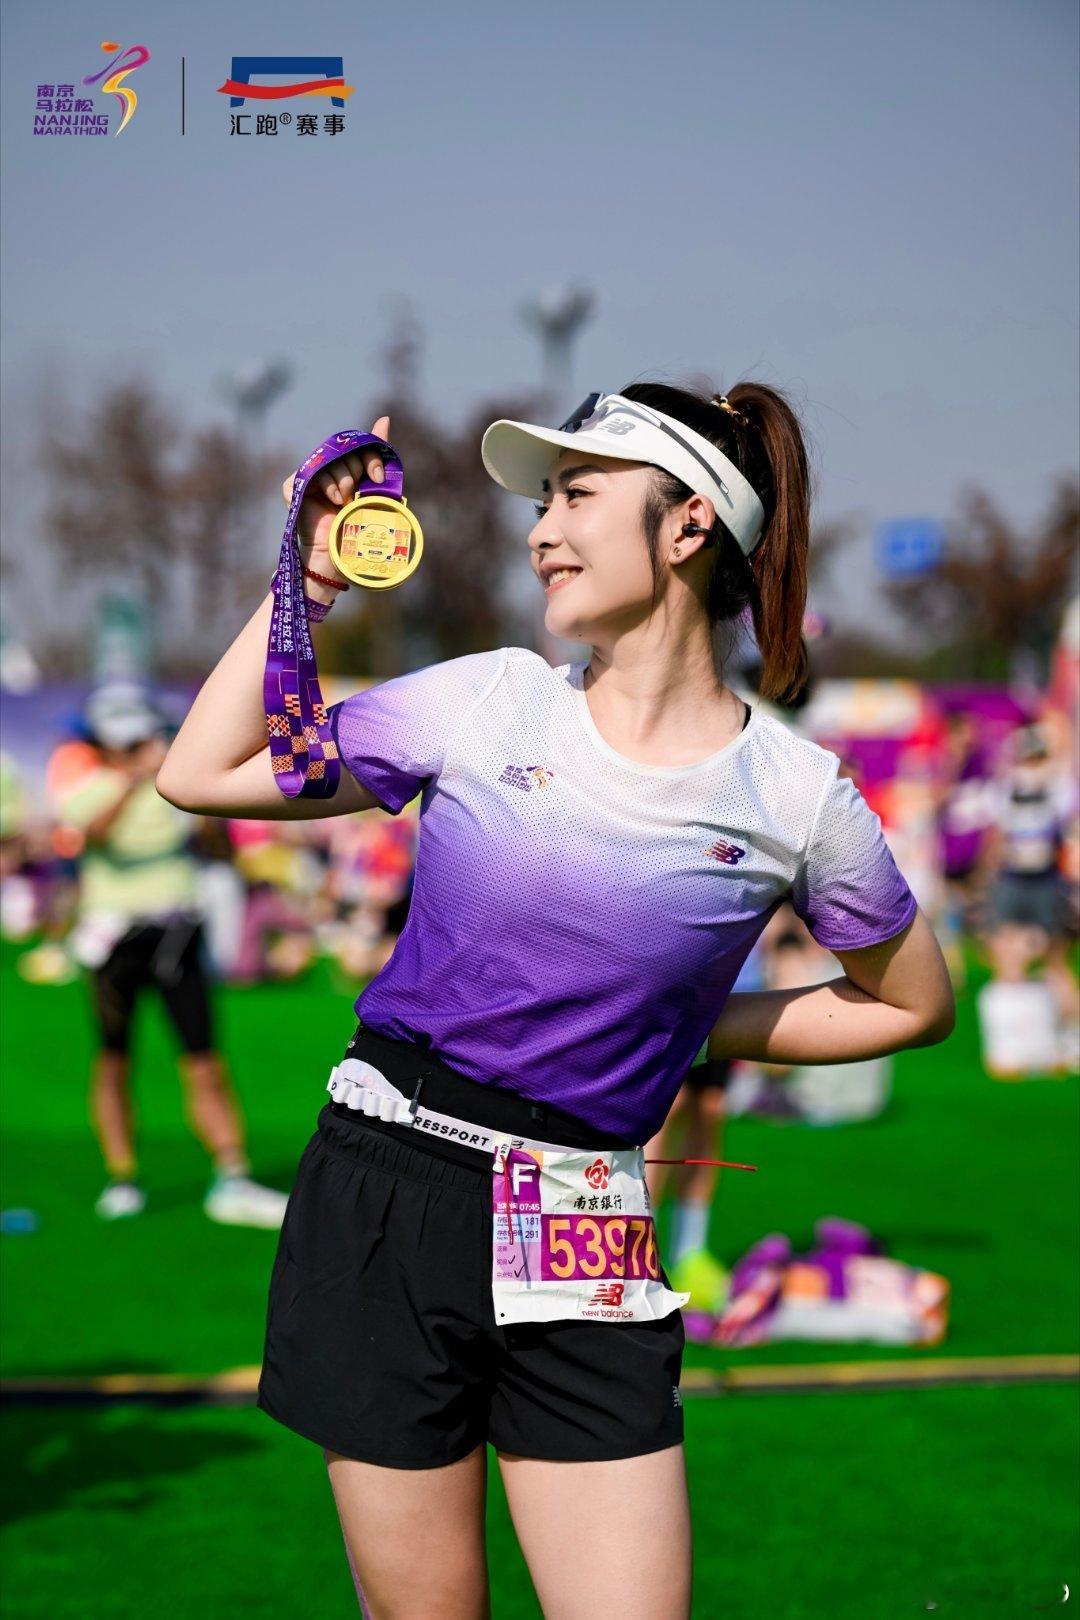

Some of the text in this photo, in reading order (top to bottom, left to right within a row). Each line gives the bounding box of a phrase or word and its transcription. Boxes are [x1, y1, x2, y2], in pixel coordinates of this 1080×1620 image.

[512, 1163, 538, 1195] F
[519, 1203, 540, 1211] 07:45
[573, 1194, 622, 1211] 南京银行
[525, 1217, 540, 1226] 181
[524, 1230, 540, 1239] 291
[582, 1308, 634, 1318] new balance
